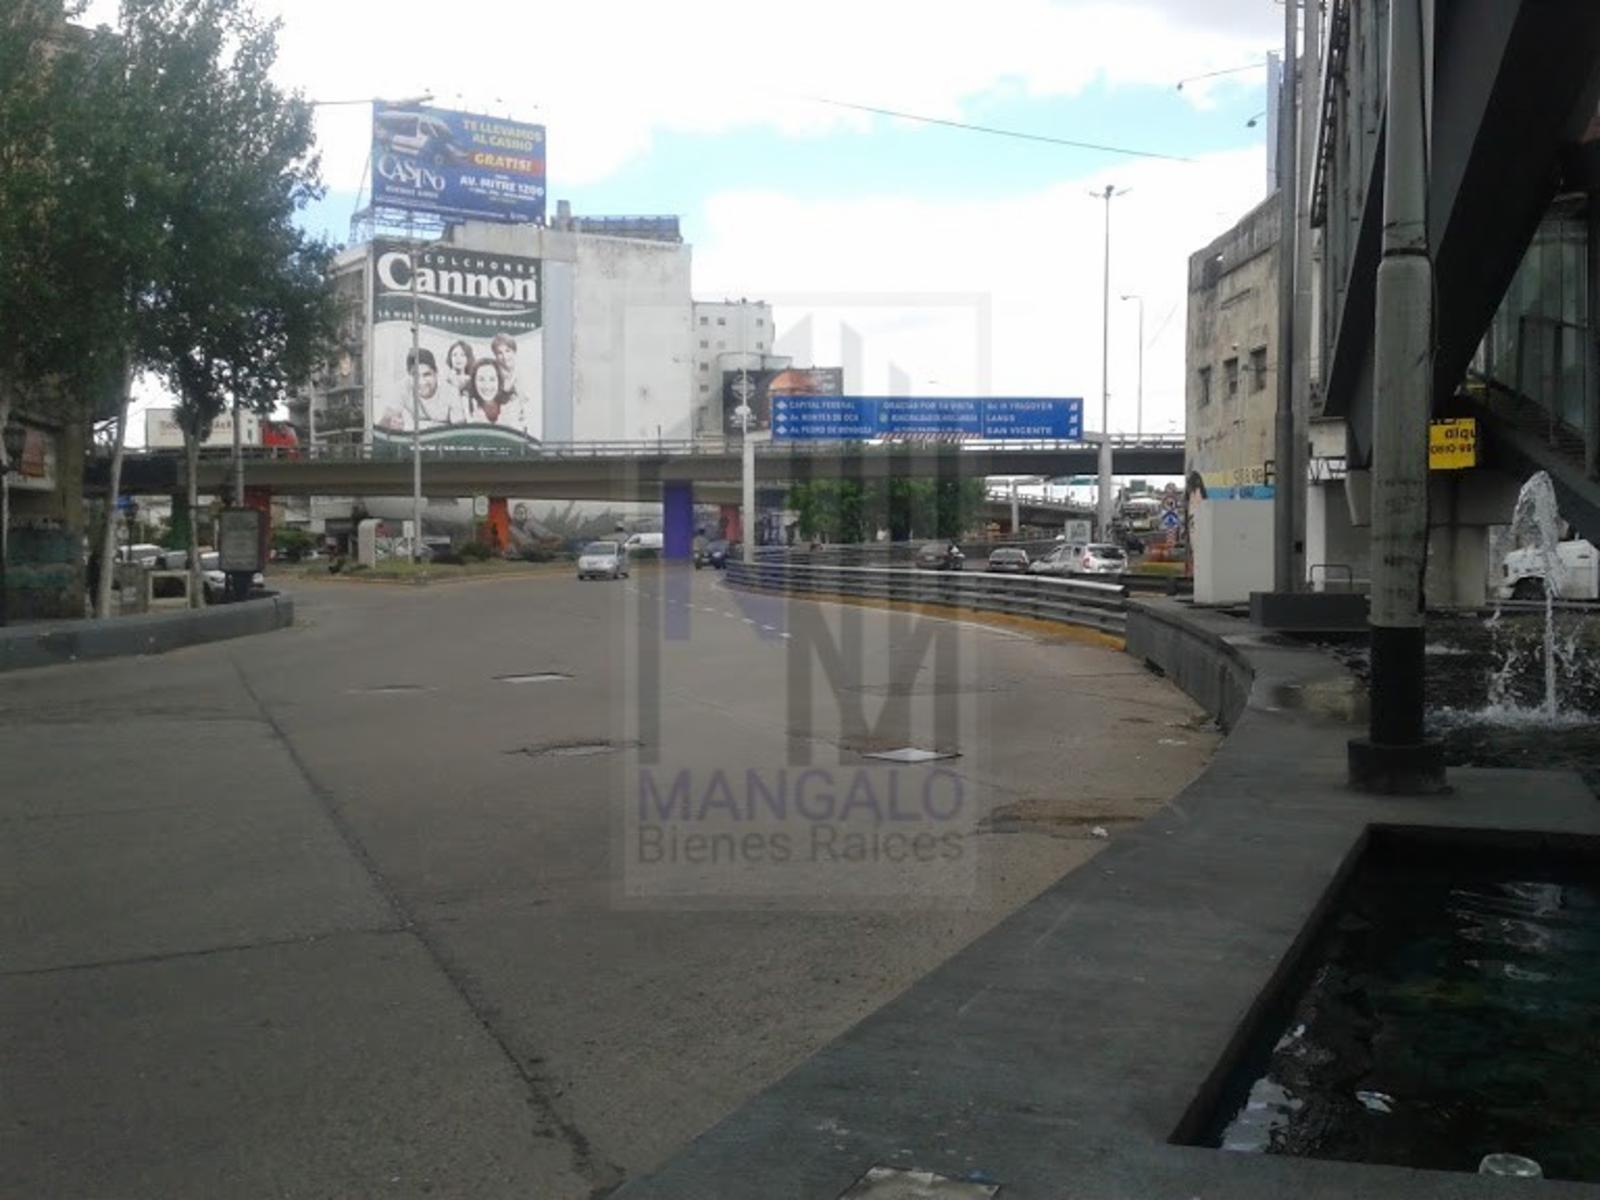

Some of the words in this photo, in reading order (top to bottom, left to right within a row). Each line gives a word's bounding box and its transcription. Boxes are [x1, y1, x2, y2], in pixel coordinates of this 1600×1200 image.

[378, 153, 445, 191] CASINO
[474, 153, 532, 172] GRATIS!
[377, 252, 538, 303] Cannon
[424, 255, 536, 274] COLCHONES
